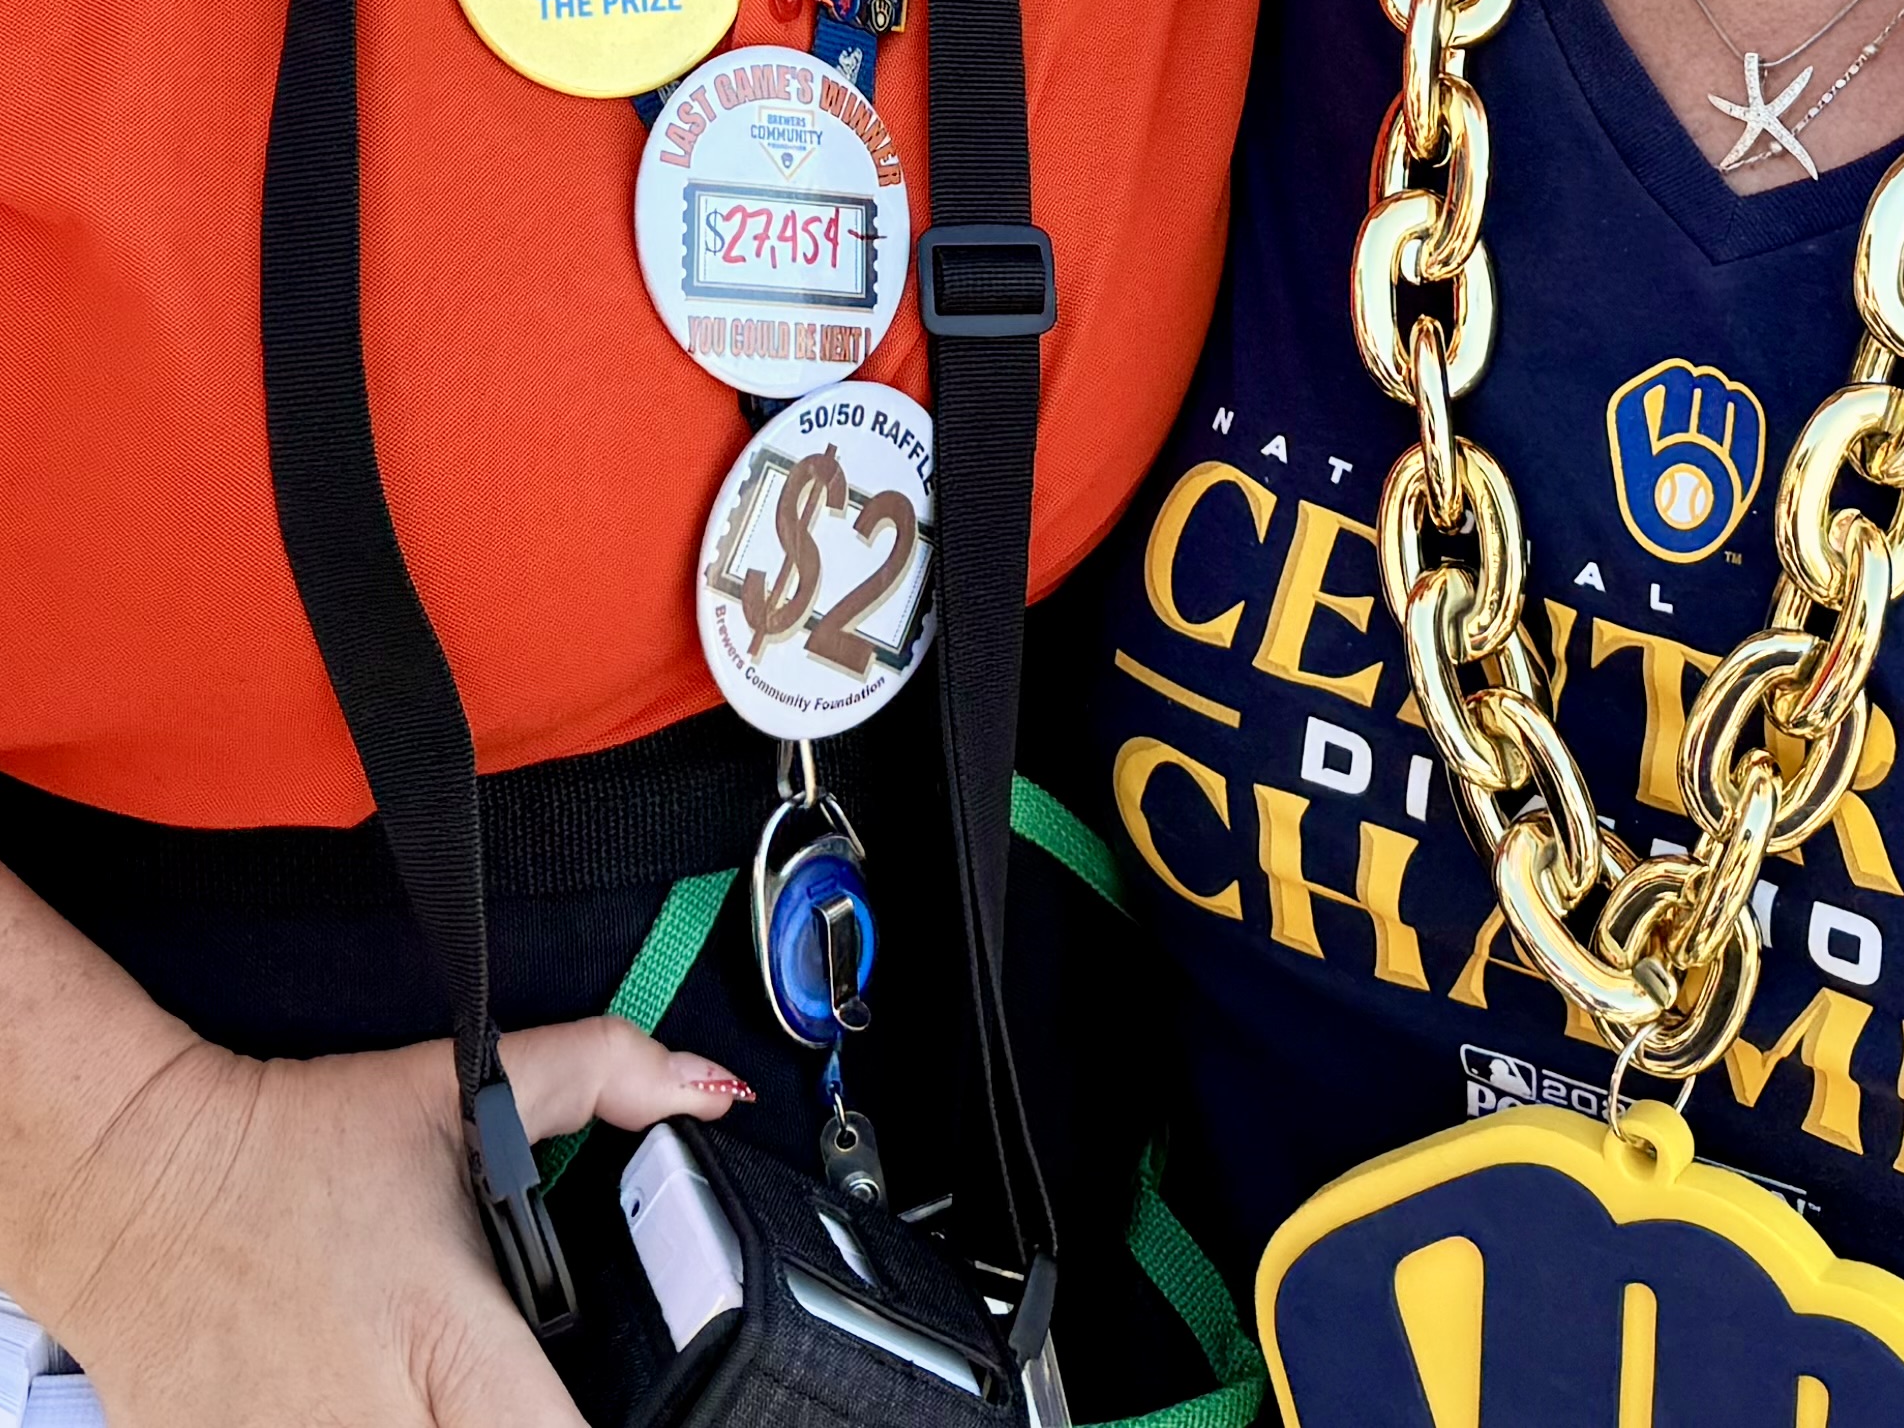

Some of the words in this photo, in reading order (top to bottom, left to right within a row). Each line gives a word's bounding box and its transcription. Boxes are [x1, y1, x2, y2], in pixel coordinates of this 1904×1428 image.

[660, 85, 716, 169] LAST
[714, 64, 814, 111] GAME'S
[819, 76, 903, 187] WINNER
[750, 124, 823, 145] COMMUNITY
[688, 316, 726, 356] YOU
[730, 318, 789, 359] COULD
[794, 322, 817, 360] BE
[819, 324, 862, 363] NEXT
[799, 403, 865, 434] 50/50
[871, 410, 936, 497] RAFFLE
[741, 442, 917, 675] $2
[714, 604, 745, 671] Brewers
[745, 665, 812, 713] Community
[813, 675, 886, 711] Foundation
